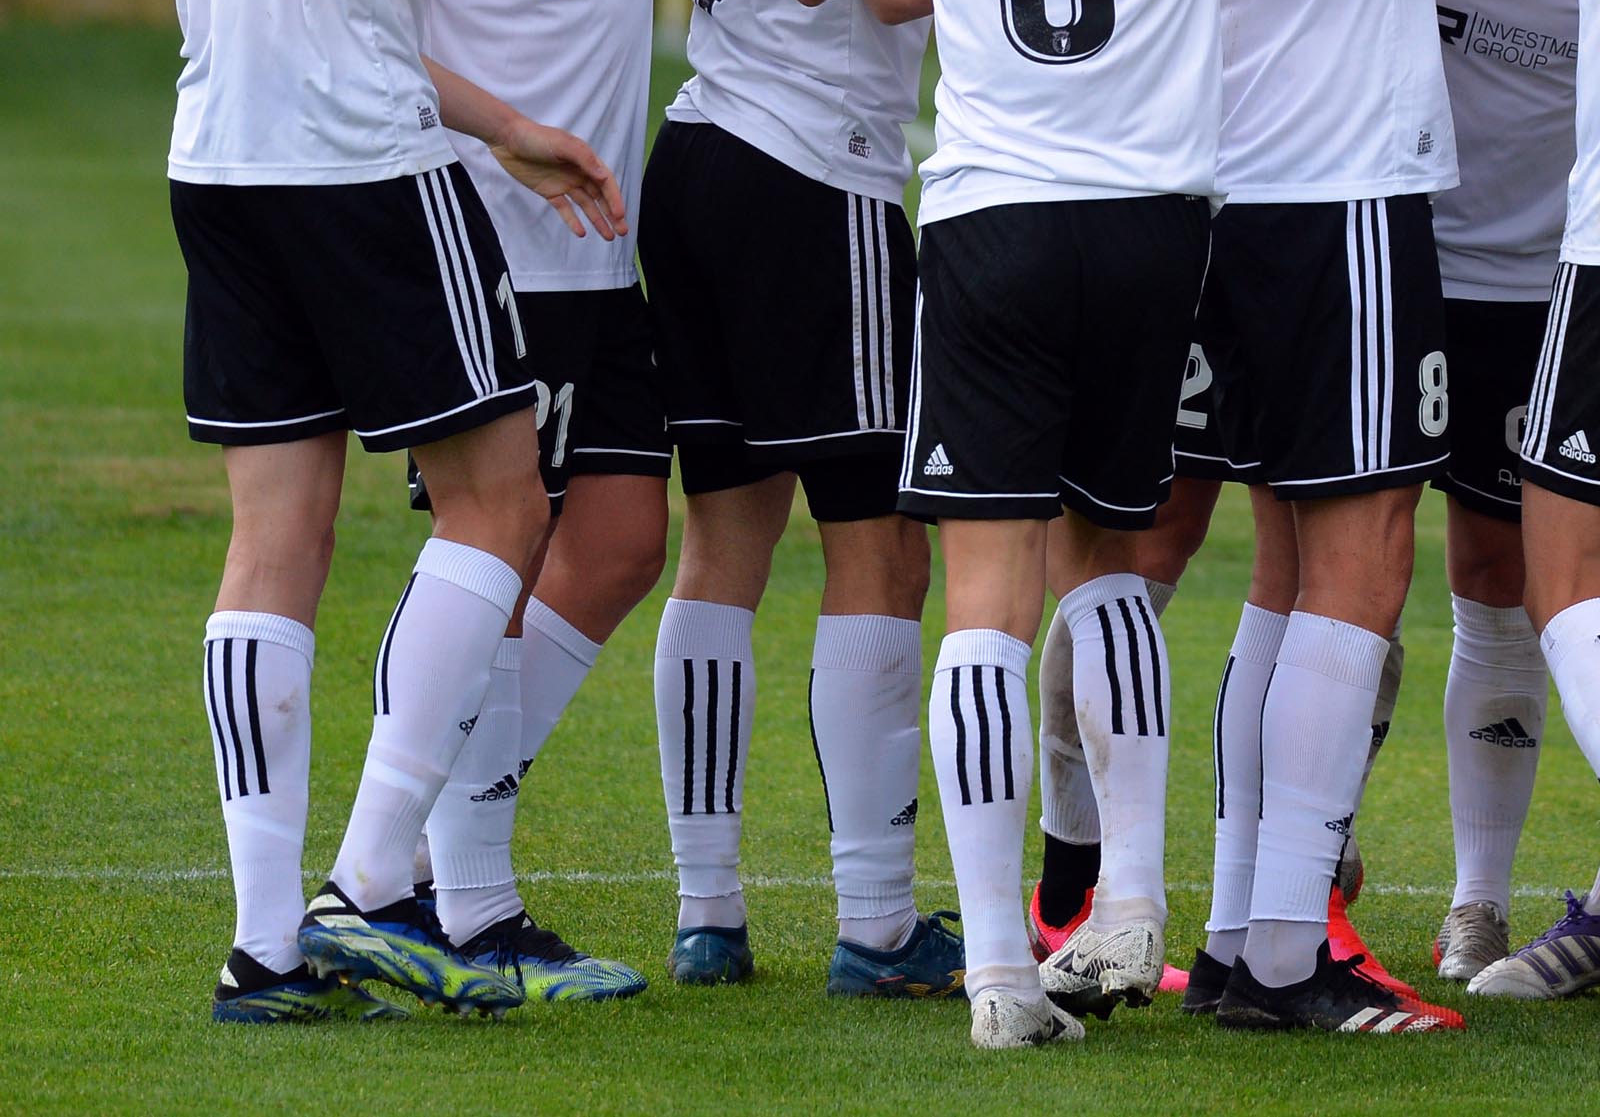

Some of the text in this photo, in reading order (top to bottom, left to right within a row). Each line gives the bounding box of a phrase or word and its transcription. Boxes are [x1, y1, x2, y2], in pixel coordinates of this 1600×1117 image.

[1473, 37, 1548, 69] GROUP
[1418, 350, 1449, 437] 8
[1559, 445, 1597, 464] adidas
[923, 463, 954, 476] adidas
[1468, 730, 1538, 749] adidas
